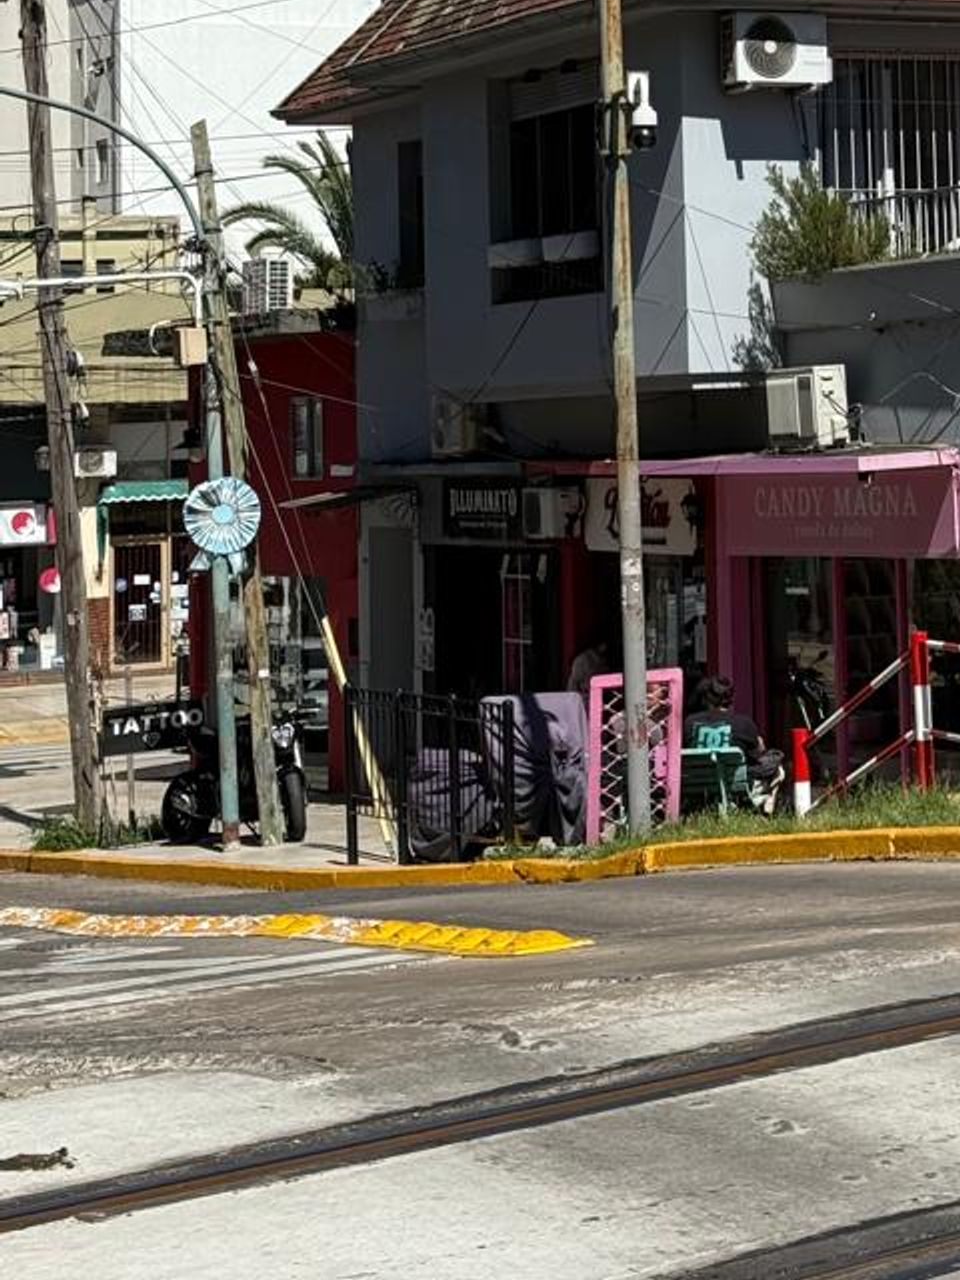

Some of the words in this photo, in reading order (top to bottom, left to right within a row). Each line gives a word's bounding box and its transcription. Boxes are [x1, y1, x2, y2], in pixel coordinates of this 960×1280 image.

[754, 486, 825, 517] CANDY
[832, 482, 917, 517] MAGNA
[109, 708, 203, 736] TATTOO
